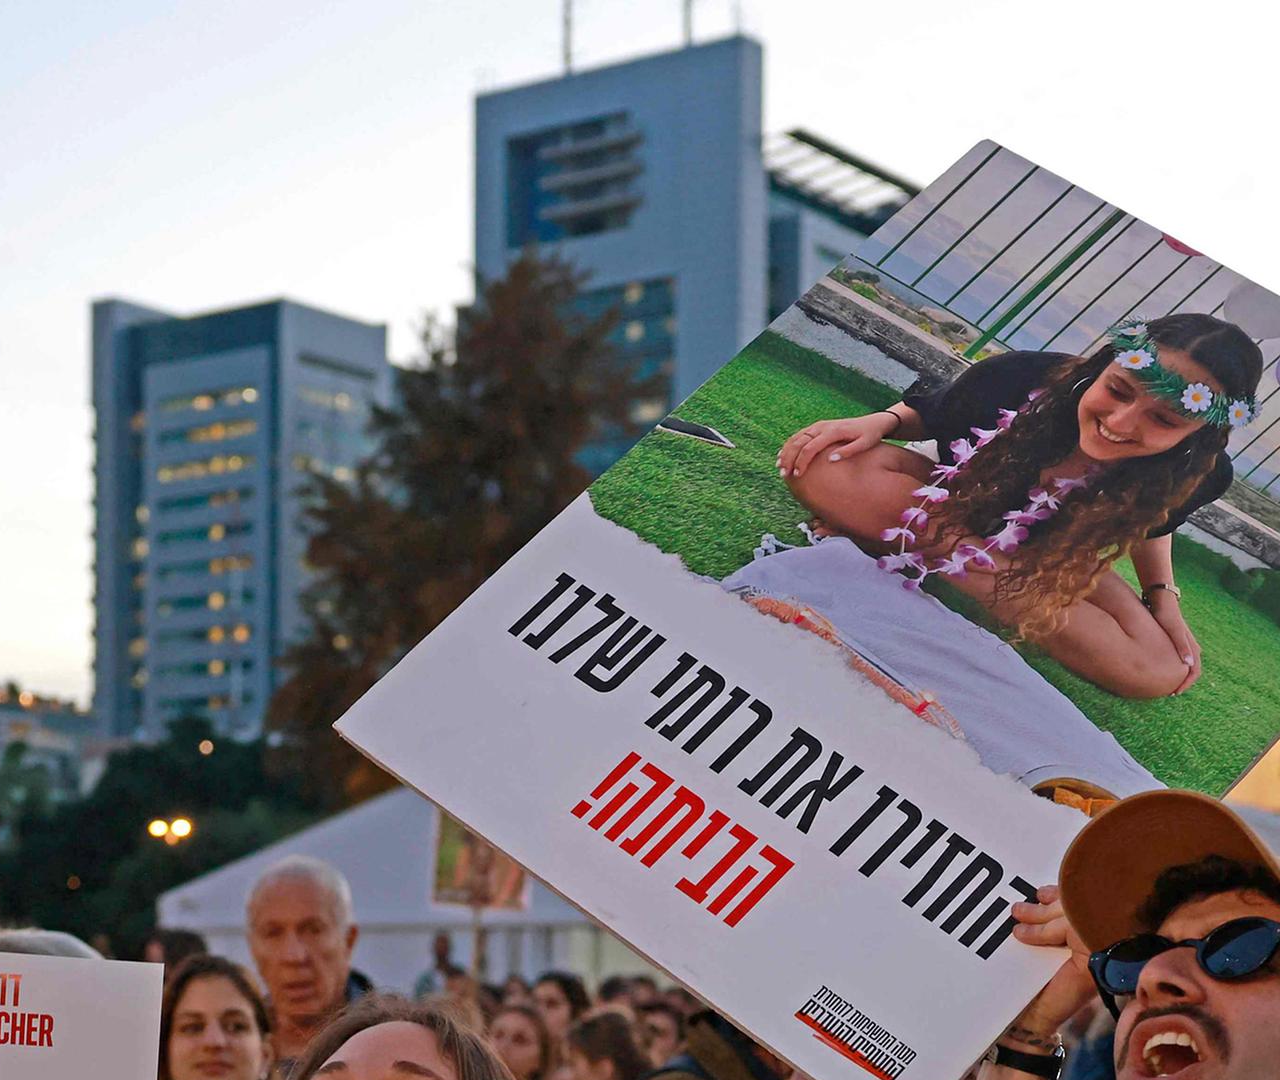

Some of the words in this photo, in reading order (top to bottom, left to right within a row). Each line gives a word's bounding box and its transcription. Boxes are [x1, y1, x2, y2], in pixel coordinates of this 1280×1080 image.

[507, 572, 667, 693] שלנו
[644, 651, 774, 774] רומי
[570, 751, 795, 928] הביתה!
[737, 726, 864, 834] את
[890, 1041, 917, 1065] מטה
